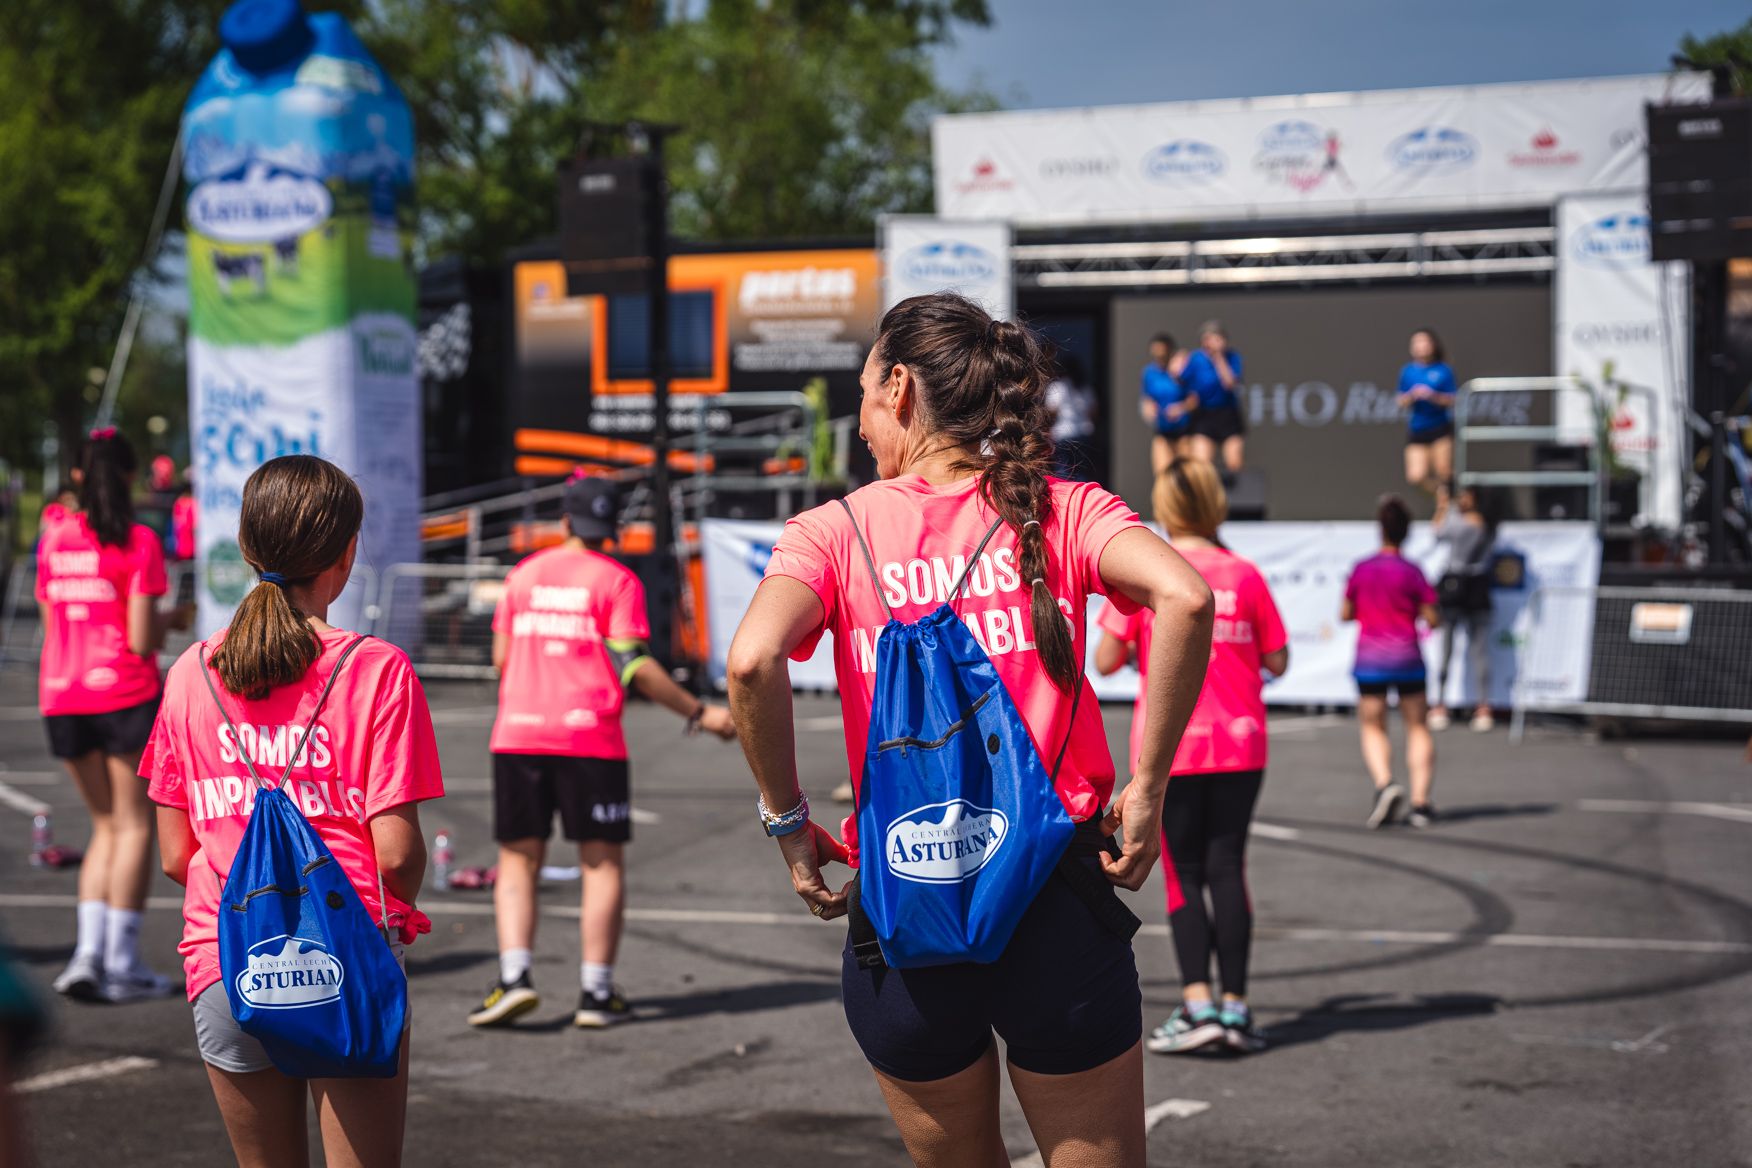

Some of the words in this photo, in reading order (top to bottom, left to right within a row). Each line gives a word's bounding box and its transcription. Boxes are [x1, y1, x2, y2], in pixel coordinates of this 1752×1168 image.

[882, 547, 1021, 608] SOMOS
[217, 722, 331, 769] SOMOS
[891, 826, 999, 864] ASTURANA
[911, 827, 960, 840] CENTRAL
[252, 959, 300, 970] CENTRAL
